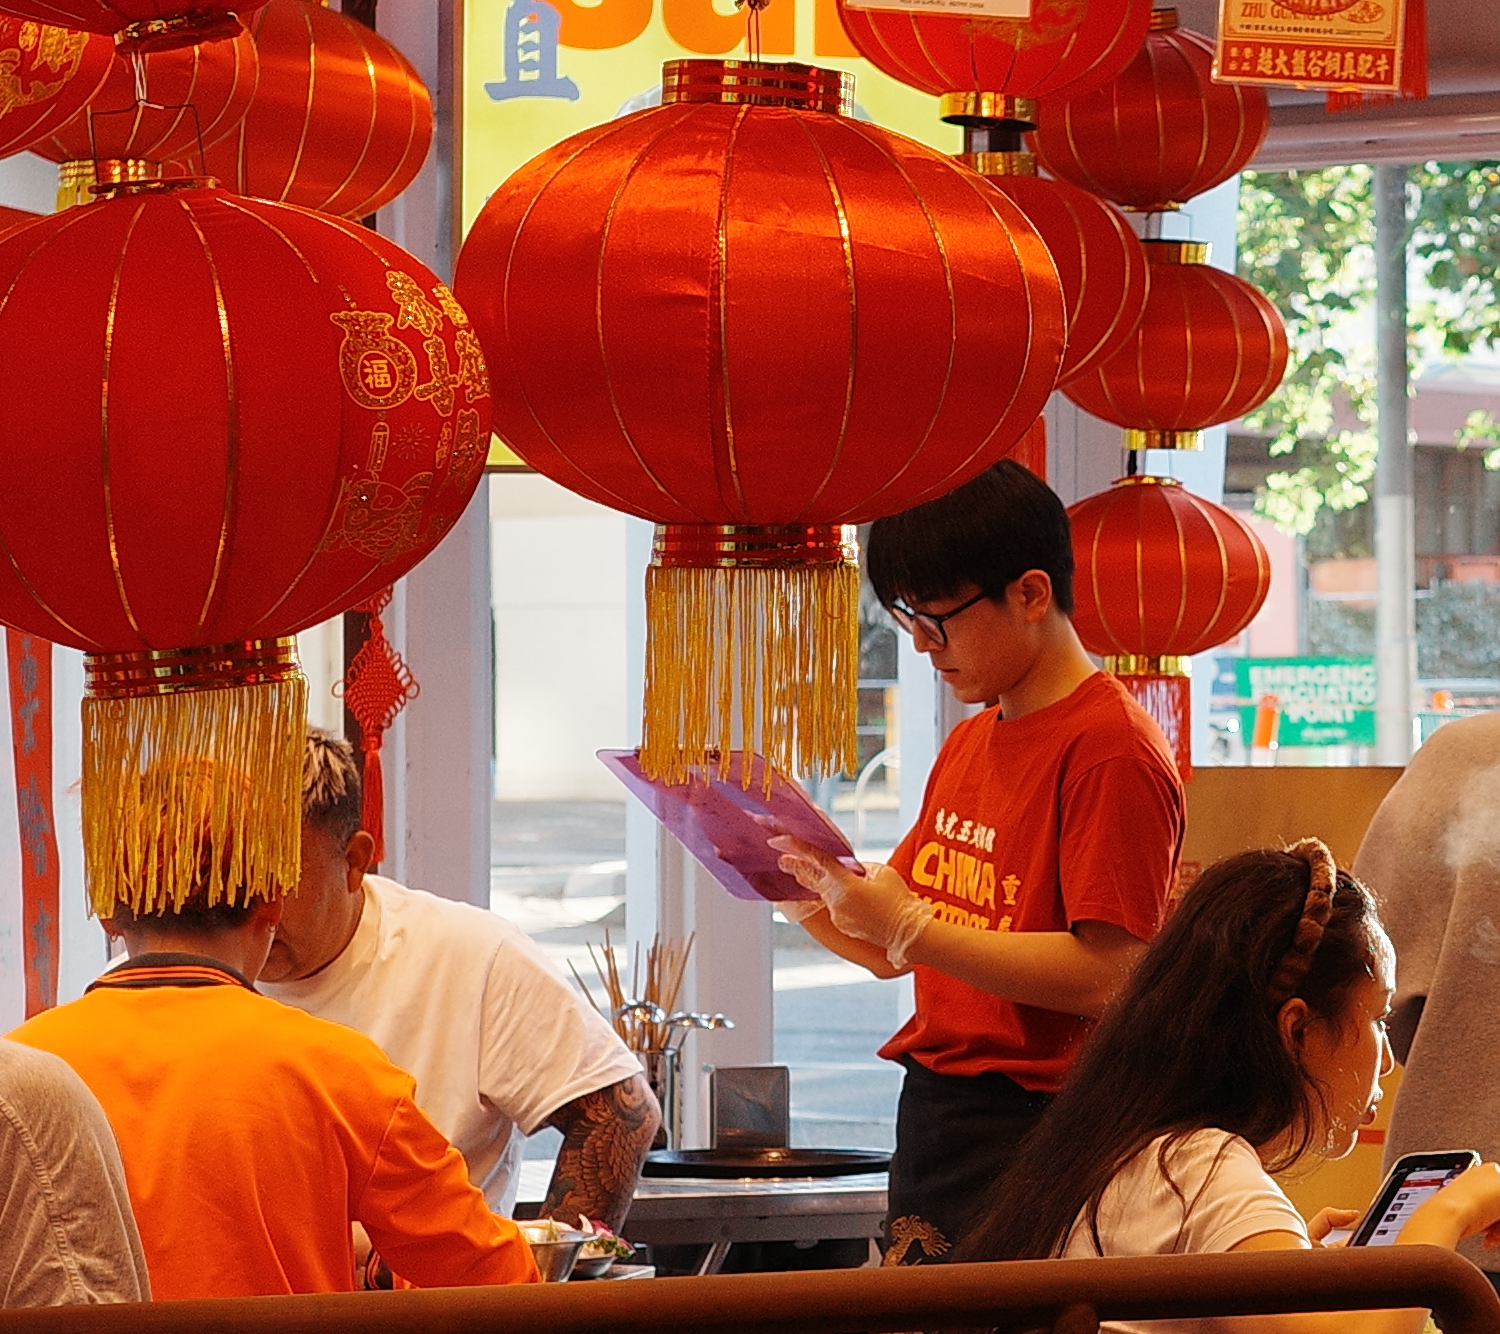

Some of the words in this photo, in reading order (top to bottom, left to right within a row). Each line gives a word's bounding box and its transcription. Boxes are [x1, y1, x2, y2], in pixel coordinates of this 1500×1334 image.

[1240, 1, 1266, 18] ZHU
[1248, 666, 1377, 687] EMERGENC
[911, 840, 998, 912] CHINA
